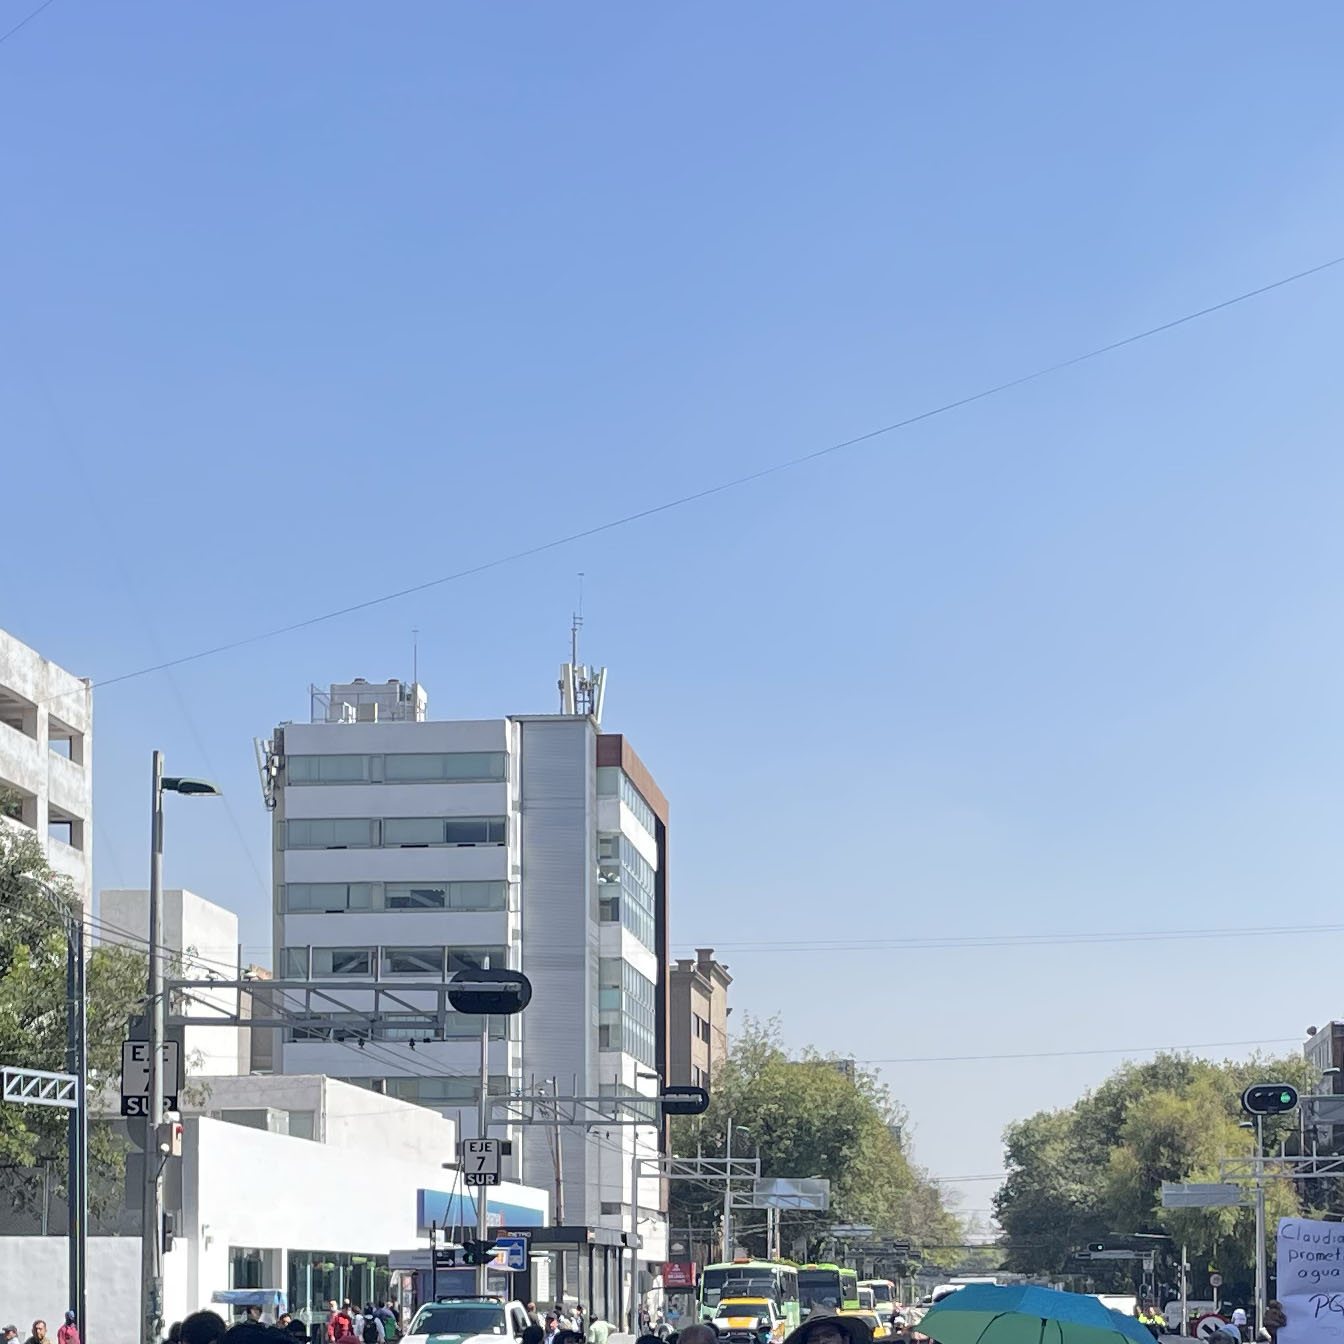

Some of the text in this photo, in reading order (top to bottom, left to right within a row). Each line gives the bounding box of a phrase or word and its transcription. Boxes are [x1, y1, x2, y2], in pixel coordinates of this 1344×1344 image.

[470, 1142, 492, 1152] EJE
[477, 1156, 485, 1171] 7
[467, 1174, 495, 1185] SUR
[1281, 1223, 1344, 1245] Claudia
[1297, 1268, 1340, 1284] agua
